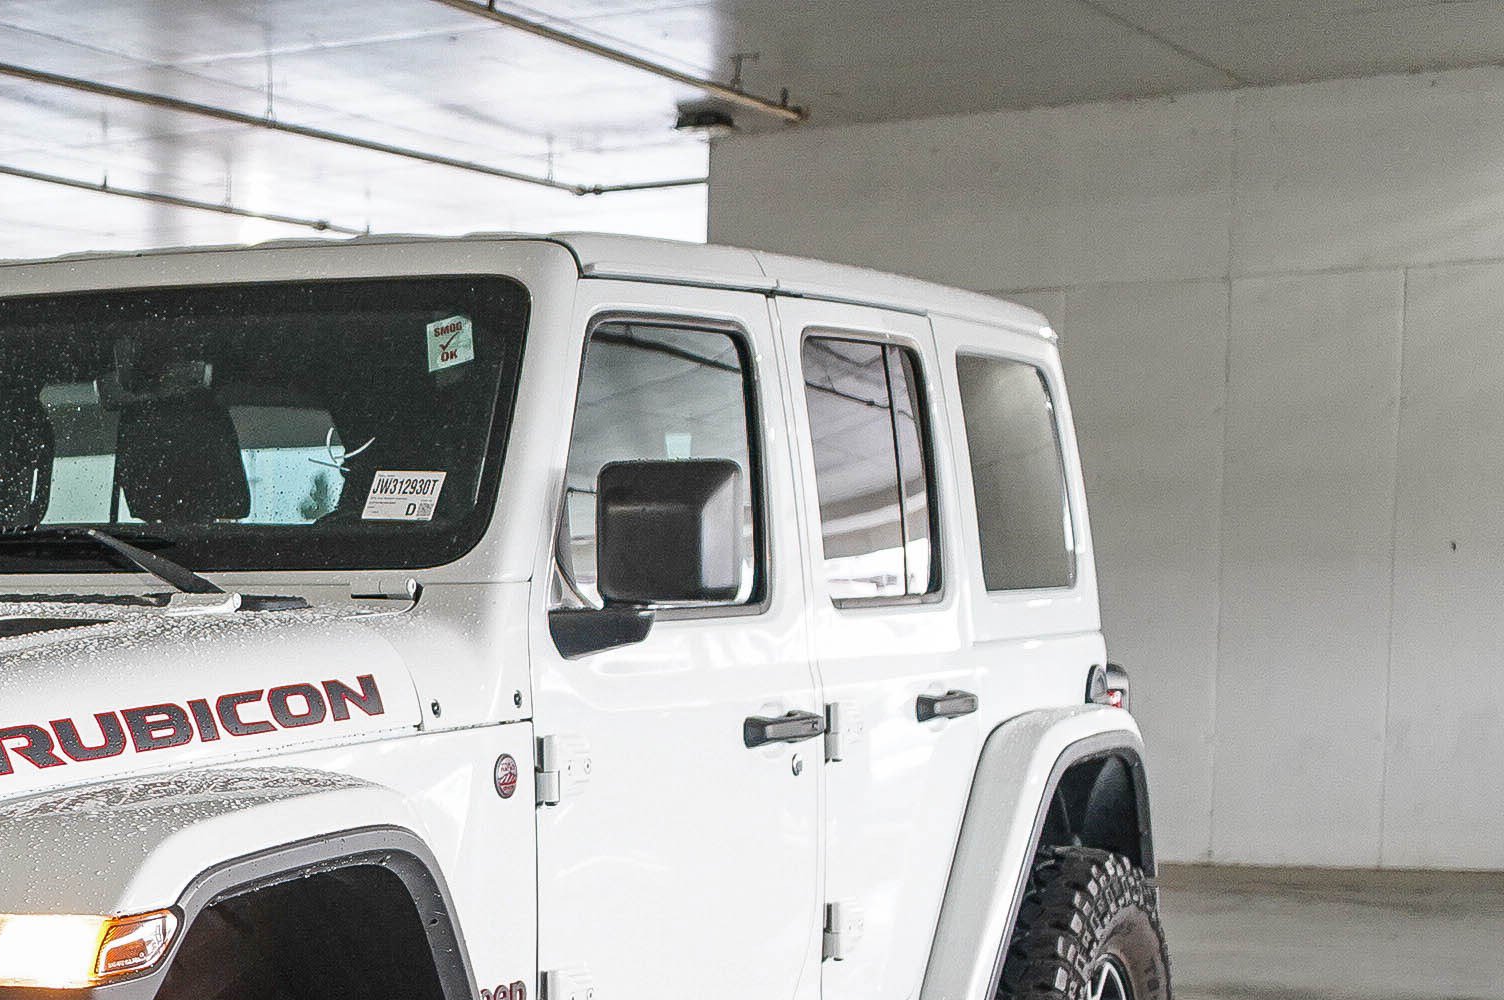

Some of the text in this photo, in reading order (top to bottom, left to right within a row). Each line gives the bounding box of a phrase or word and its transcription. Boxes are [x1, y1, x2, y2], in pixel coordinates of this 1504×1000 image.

[433, 321, 463, 337] SMOG
[440, 349, 458, 362] OK
[405, 503, 417, 516] D
